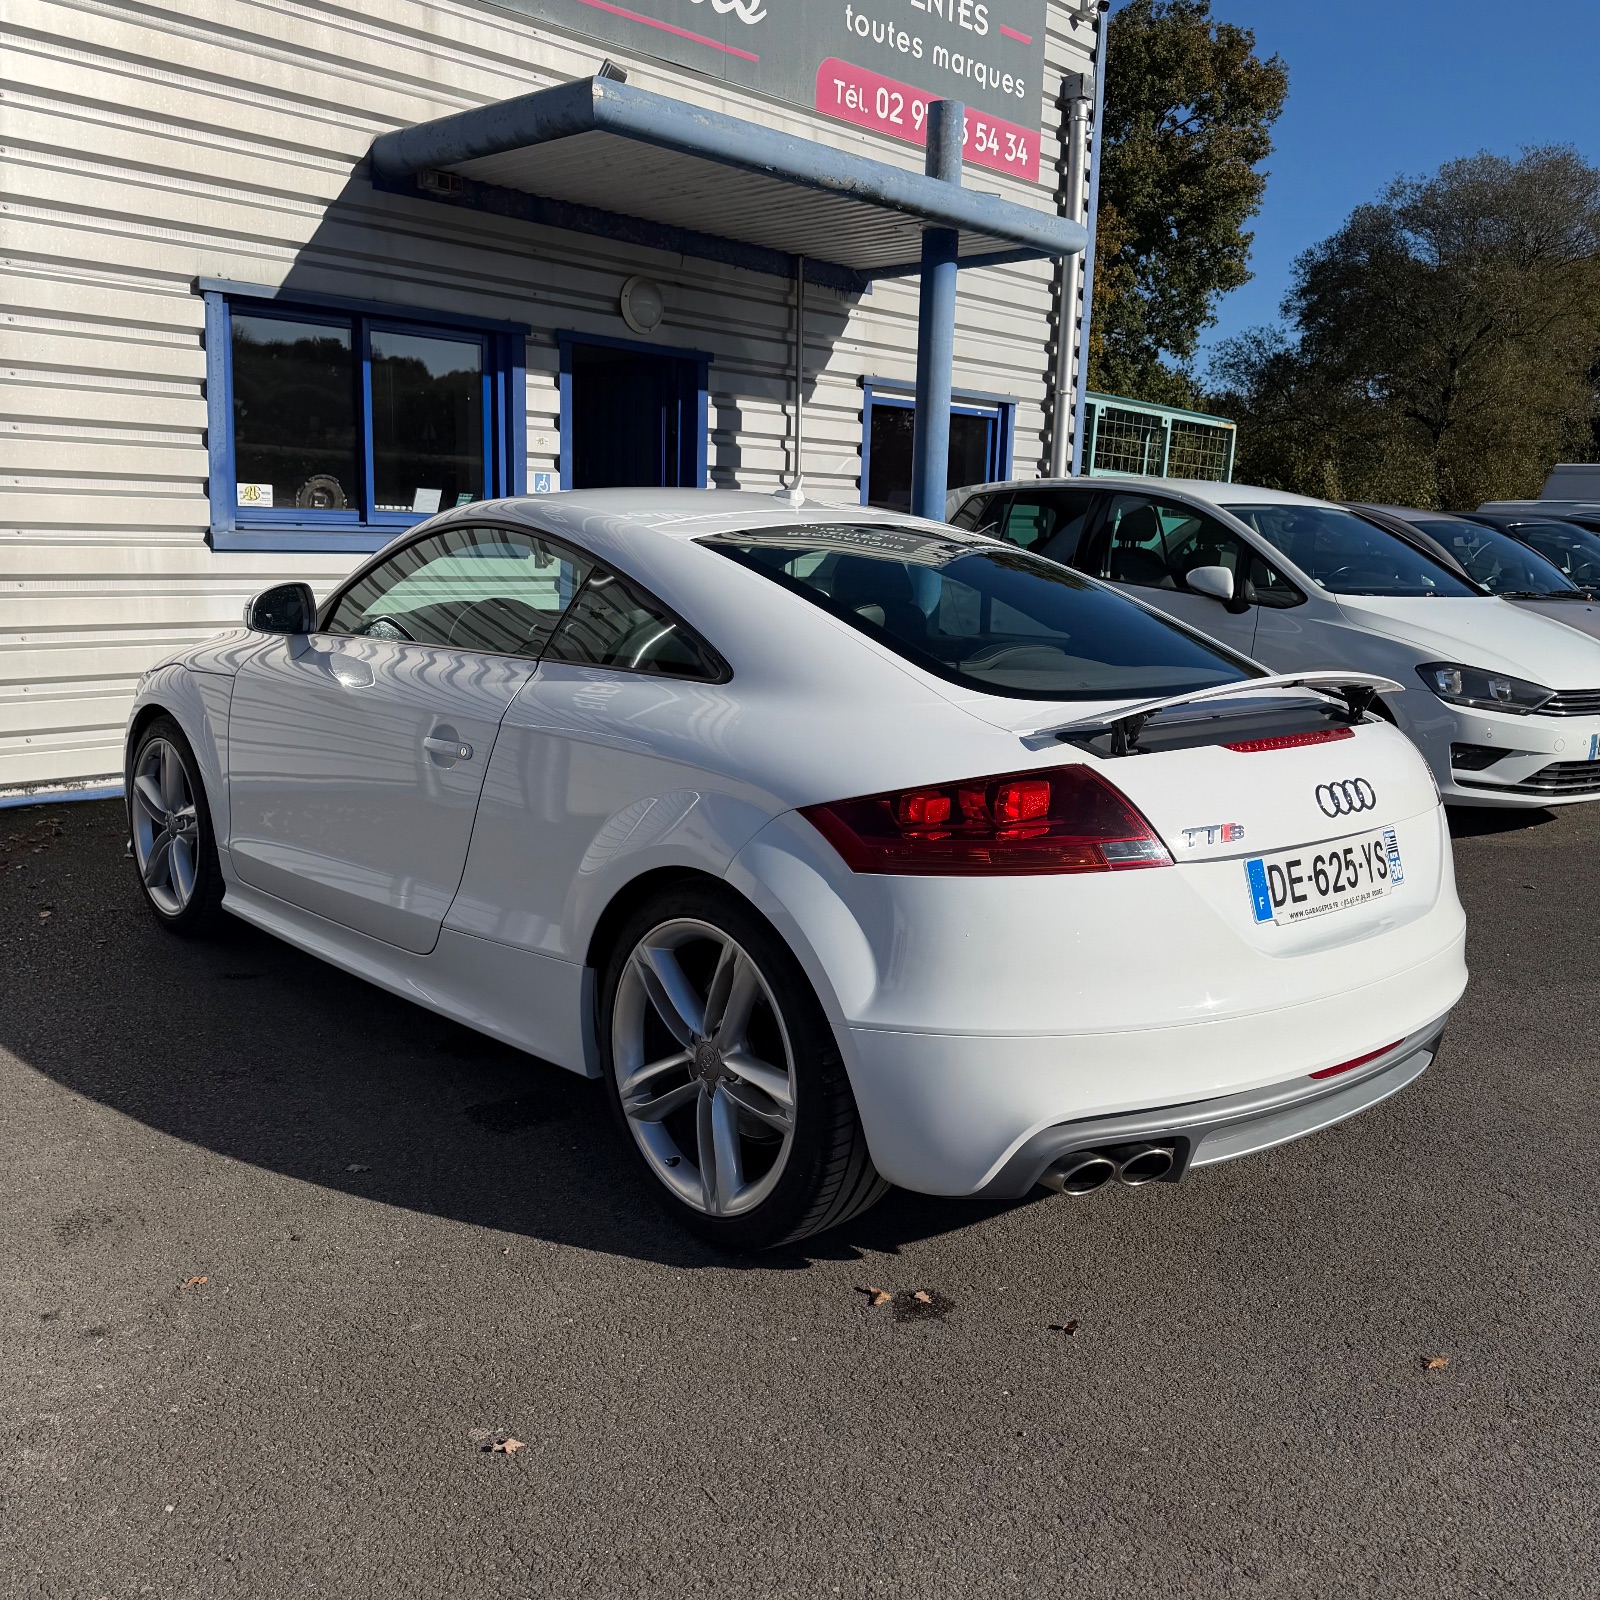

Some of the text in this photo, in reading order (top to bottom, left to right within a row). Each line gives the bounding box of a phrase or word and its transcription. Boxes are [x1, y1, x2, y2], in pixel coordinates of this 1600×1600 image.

[845, 4, 1025, 99] toutes marques
[833, 78, 869, 114] Tél.
[875, 87, 904, 125] 02
[975, 122, 1000, 156] 54
[1004, 132, 1028, 166] 34
[1258, 896, 1265, 910] F
[1267, 840, 1388, 908] DE-625-YS
